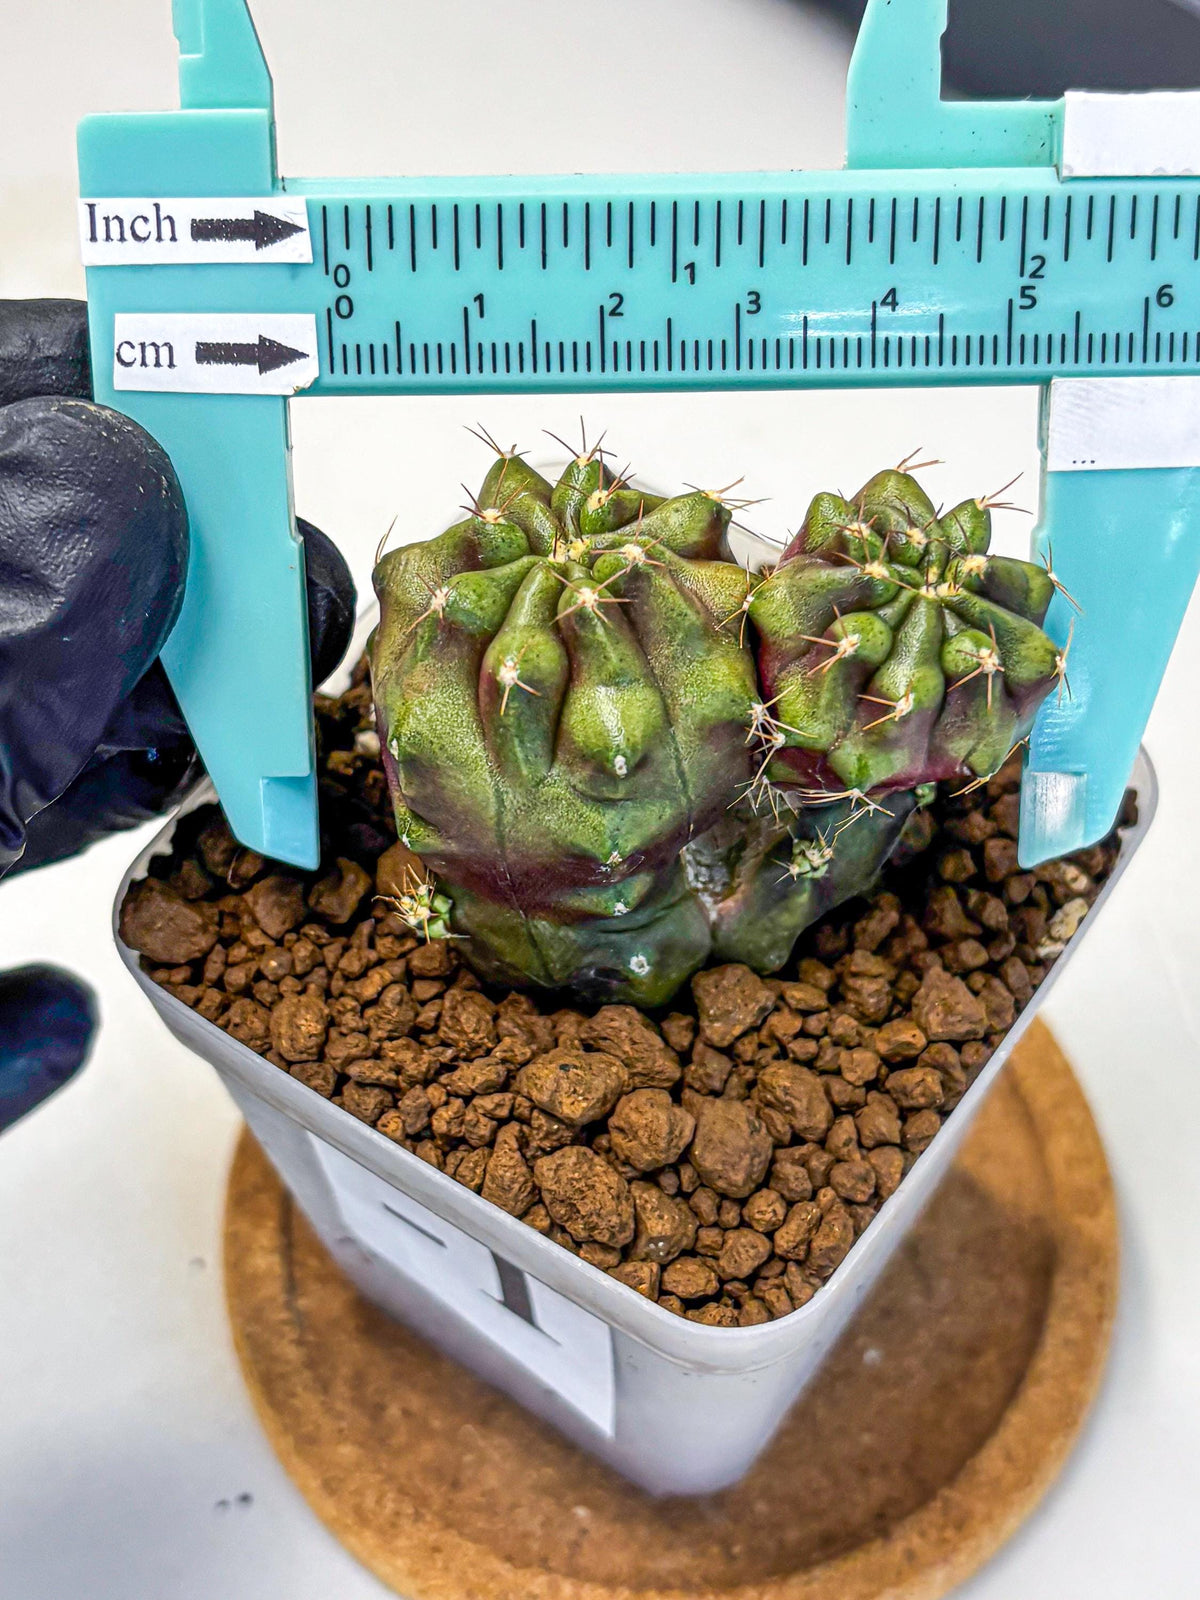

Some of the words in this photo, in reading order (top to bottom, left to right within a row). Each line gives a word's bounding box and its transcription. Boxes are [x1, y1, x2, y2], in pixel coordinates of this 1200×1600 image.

[86, 202, 178, 243] Inch
[332, 263, 351, 289] 0
[683, 261, 696, 286] 1
[1028, 254, 1046, 280] 2
[334, 294, 354, 320] 0
[472, 292, 486, 319] 1
[608, 292, 625, 317] 2
[746, 290, 762, 315] 3
[879, 286, 900, 312] 4
[1018, 285, 1038, 310] 5
[1155, 283, 1174, 308] 6
[115, 339, 177, 369] cm
